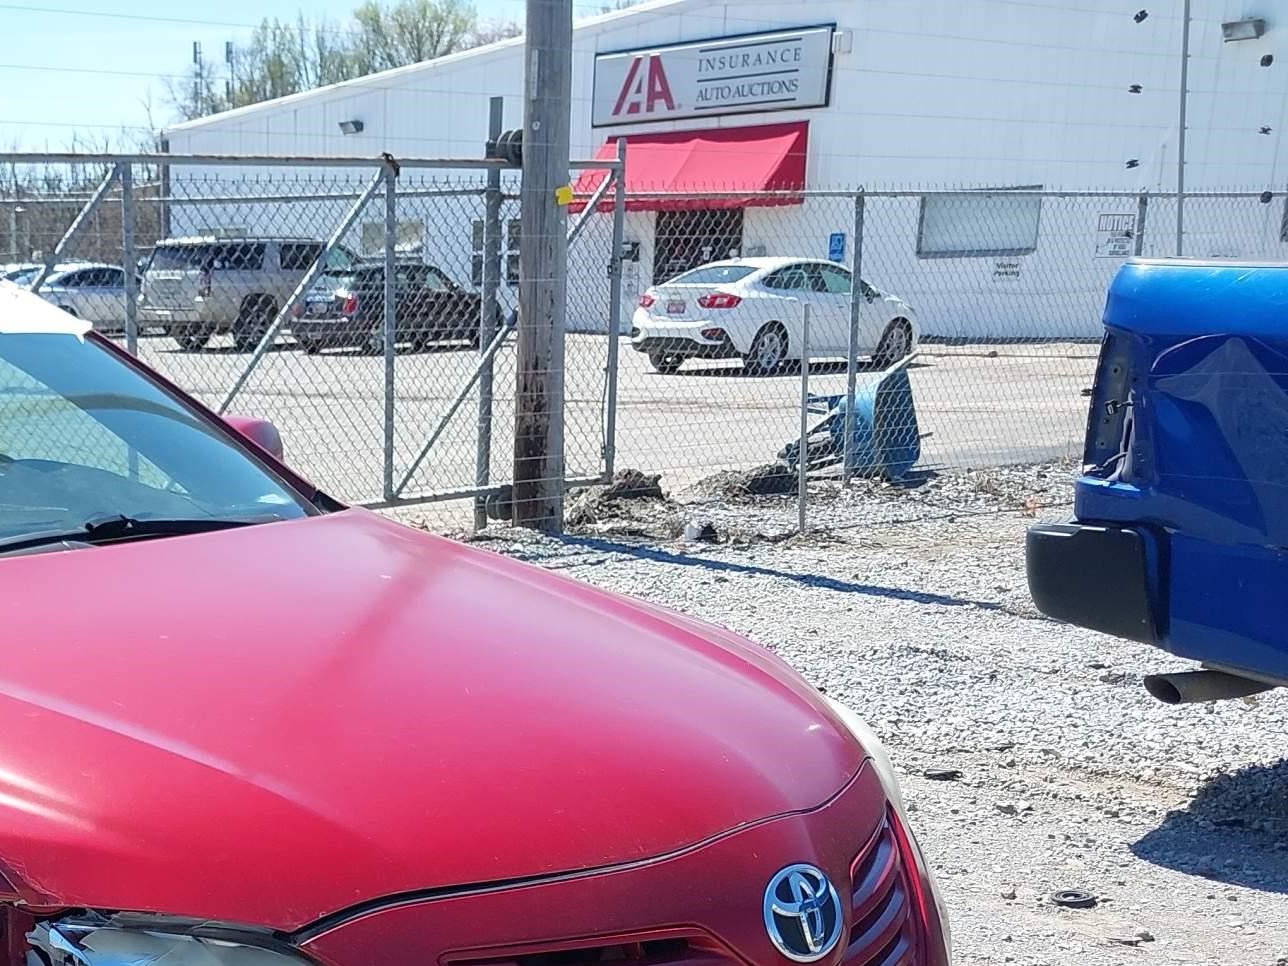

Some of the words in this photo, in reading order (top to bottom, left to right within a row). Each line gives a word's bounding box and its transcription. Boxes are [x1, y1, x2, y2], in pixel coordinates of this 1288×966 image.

[698, 48, 803, 73] INSURANCE
[696, 84, 732, 103] AUTO
[731, 78, 799, 99] AUCTIONS
[1099, 215, 1134, 231] NOTICE
